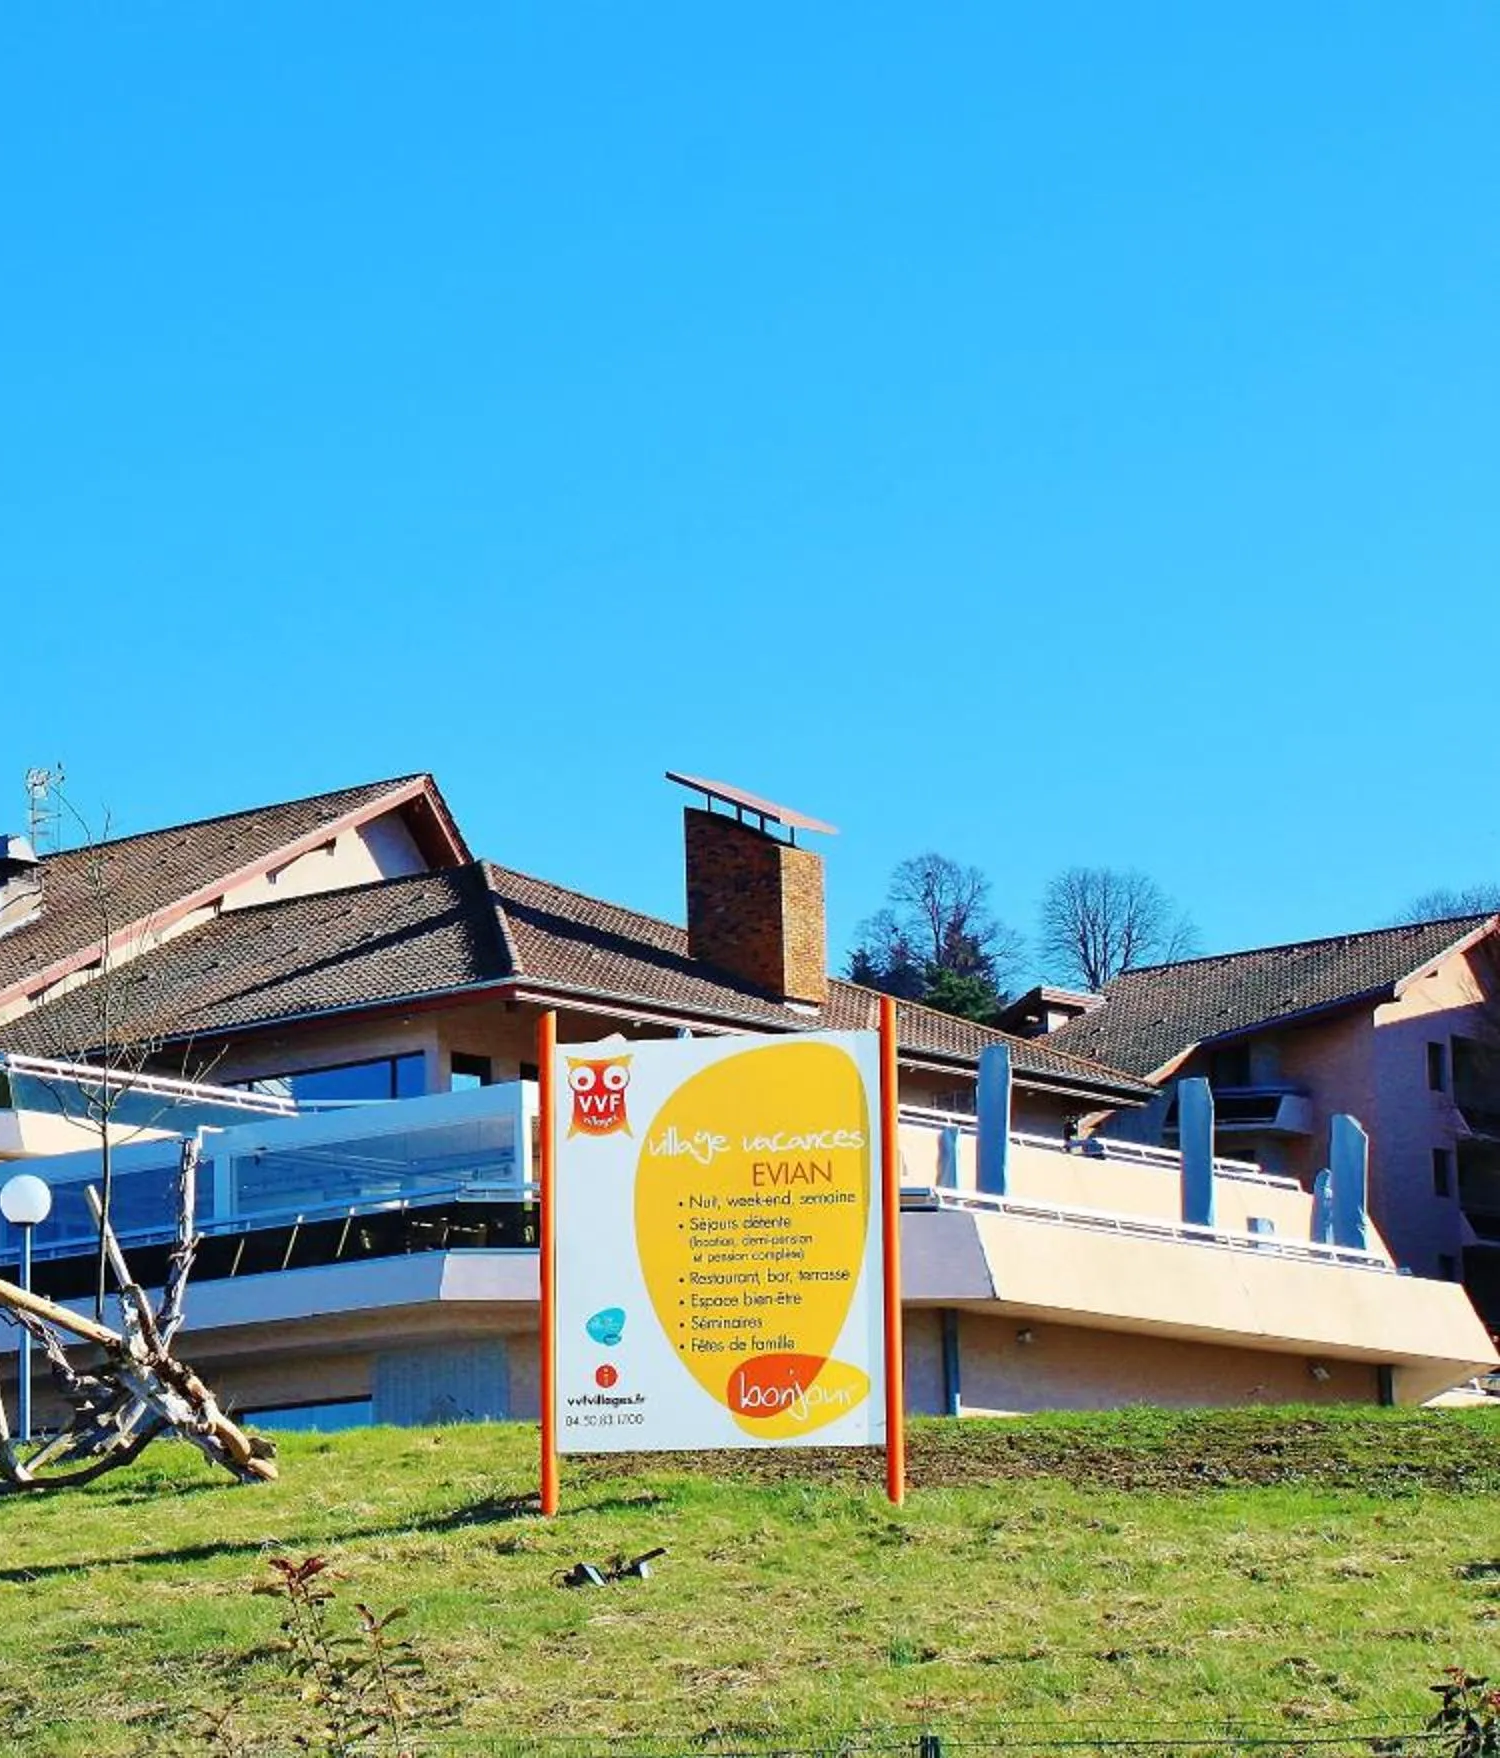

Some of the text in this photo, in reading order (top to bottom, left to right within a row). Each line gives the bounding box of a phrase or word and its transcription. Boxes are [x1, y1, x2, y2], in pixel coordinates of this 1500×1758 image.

[578, 1093, 621, 1113] VVF
[649, 1126, 866, 1165] village vacances
[752, 1160, 833, 1187] EVIAN
[799, 1190, 856, 1205] semaine
[689, 1216, 791, 1233] Séjours détente
[741, 1234, 813, 1247] demi-pension
[707, 1252, 748, 1264] pension
[797, 1268, 850, 1281] terrasse
[690, 1294, 739, 1310] Espace
[690, 1315, 763, 1330] Séminaires
[691, 1333, 795, 1352] Fêtes de famille
[739, 1369, 857, 1419] bonjour
